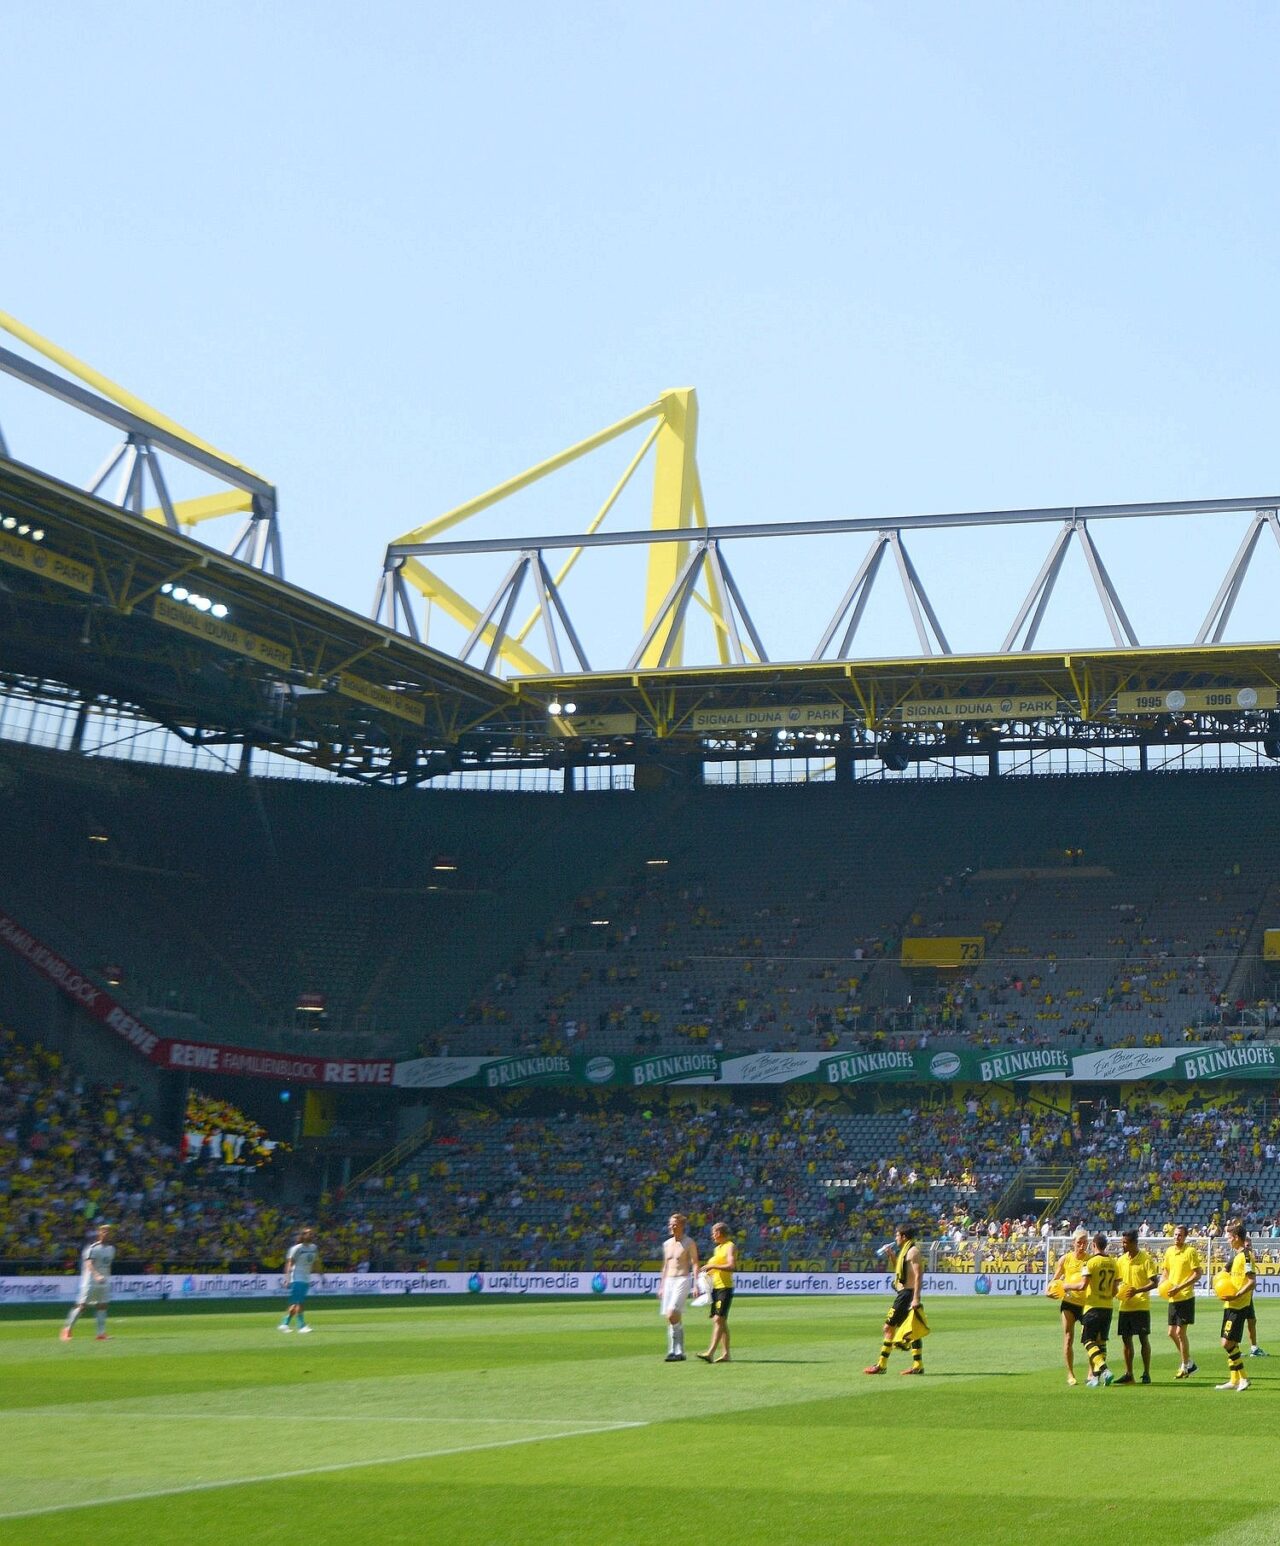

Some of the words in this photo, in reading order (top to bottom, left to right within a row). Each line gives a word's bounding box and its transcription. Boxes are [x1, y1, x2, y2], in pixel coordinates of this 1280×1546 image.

[1136, 696, 1162, 708] 1995
[1205, 694, 1232, 706] 1996
[698, 713, 741, 725] SIGNAL
[745, 712, 782, 723] IDUNA
[807, 709, 840, 720] PARK
[907, 705, 952, 717] SIGNAL
[955, 703, 994, 714] IDUNA
[1019, 701, 1053, 712] PARK
[960, 943, 980, 960] 73
[106, 1006, 159, 1054] REWE
[170, 1043, 220, 1070] REWE
[222, 1052, 318, 1079] FAMILIENBLOCK
[324, 1062, 391, 1083] REWE
[1093, 1058, 1110, 1076] Ein
[1109, 1050, 1135, 1063] Bier
[200, 1276, 268, 1294] unitymedia
[489, 1272, 579, 1294] unitymedia
[786, 1276, 832, 1291] surfen.
[837, 1276, 880, 1290] Besser
[1099, 1269, 1115, 1291] 27
